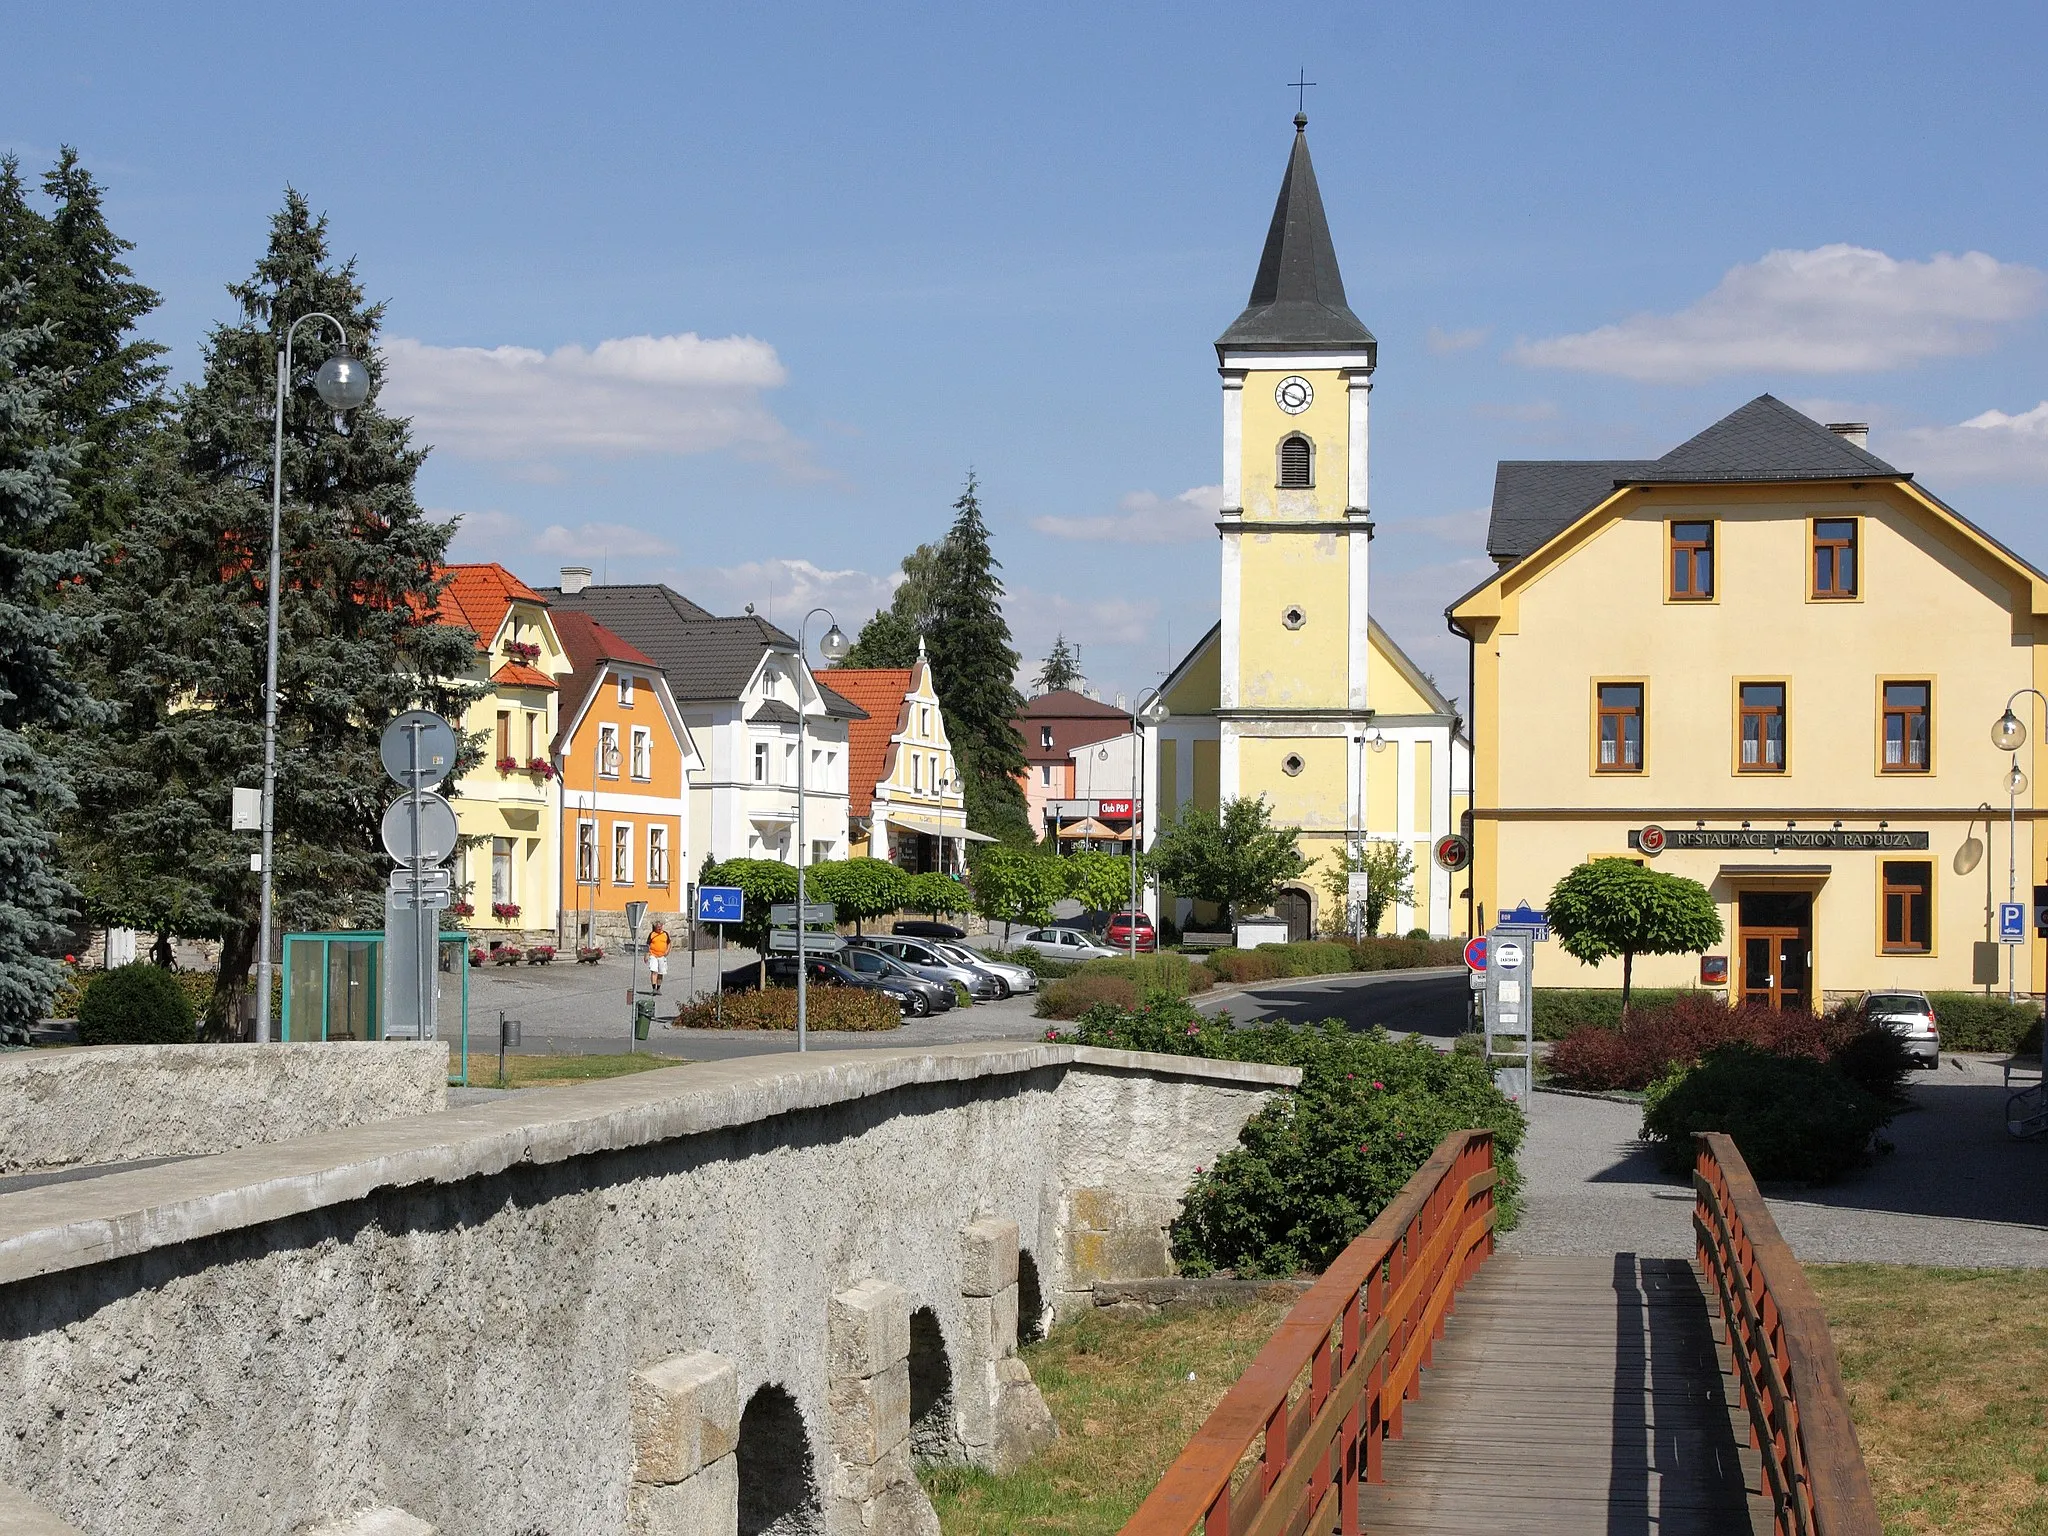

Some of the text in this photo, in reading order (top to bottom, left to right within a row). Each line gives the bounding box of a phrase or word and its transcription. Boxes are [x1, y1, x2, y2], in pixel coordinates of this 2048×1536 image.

[1101, 803, 1129, 813] Club P&P
[1678, 833, 1912, 846] RESTAURACE PENZION RADBUZA
[2004, 906, 2020, 927] P
